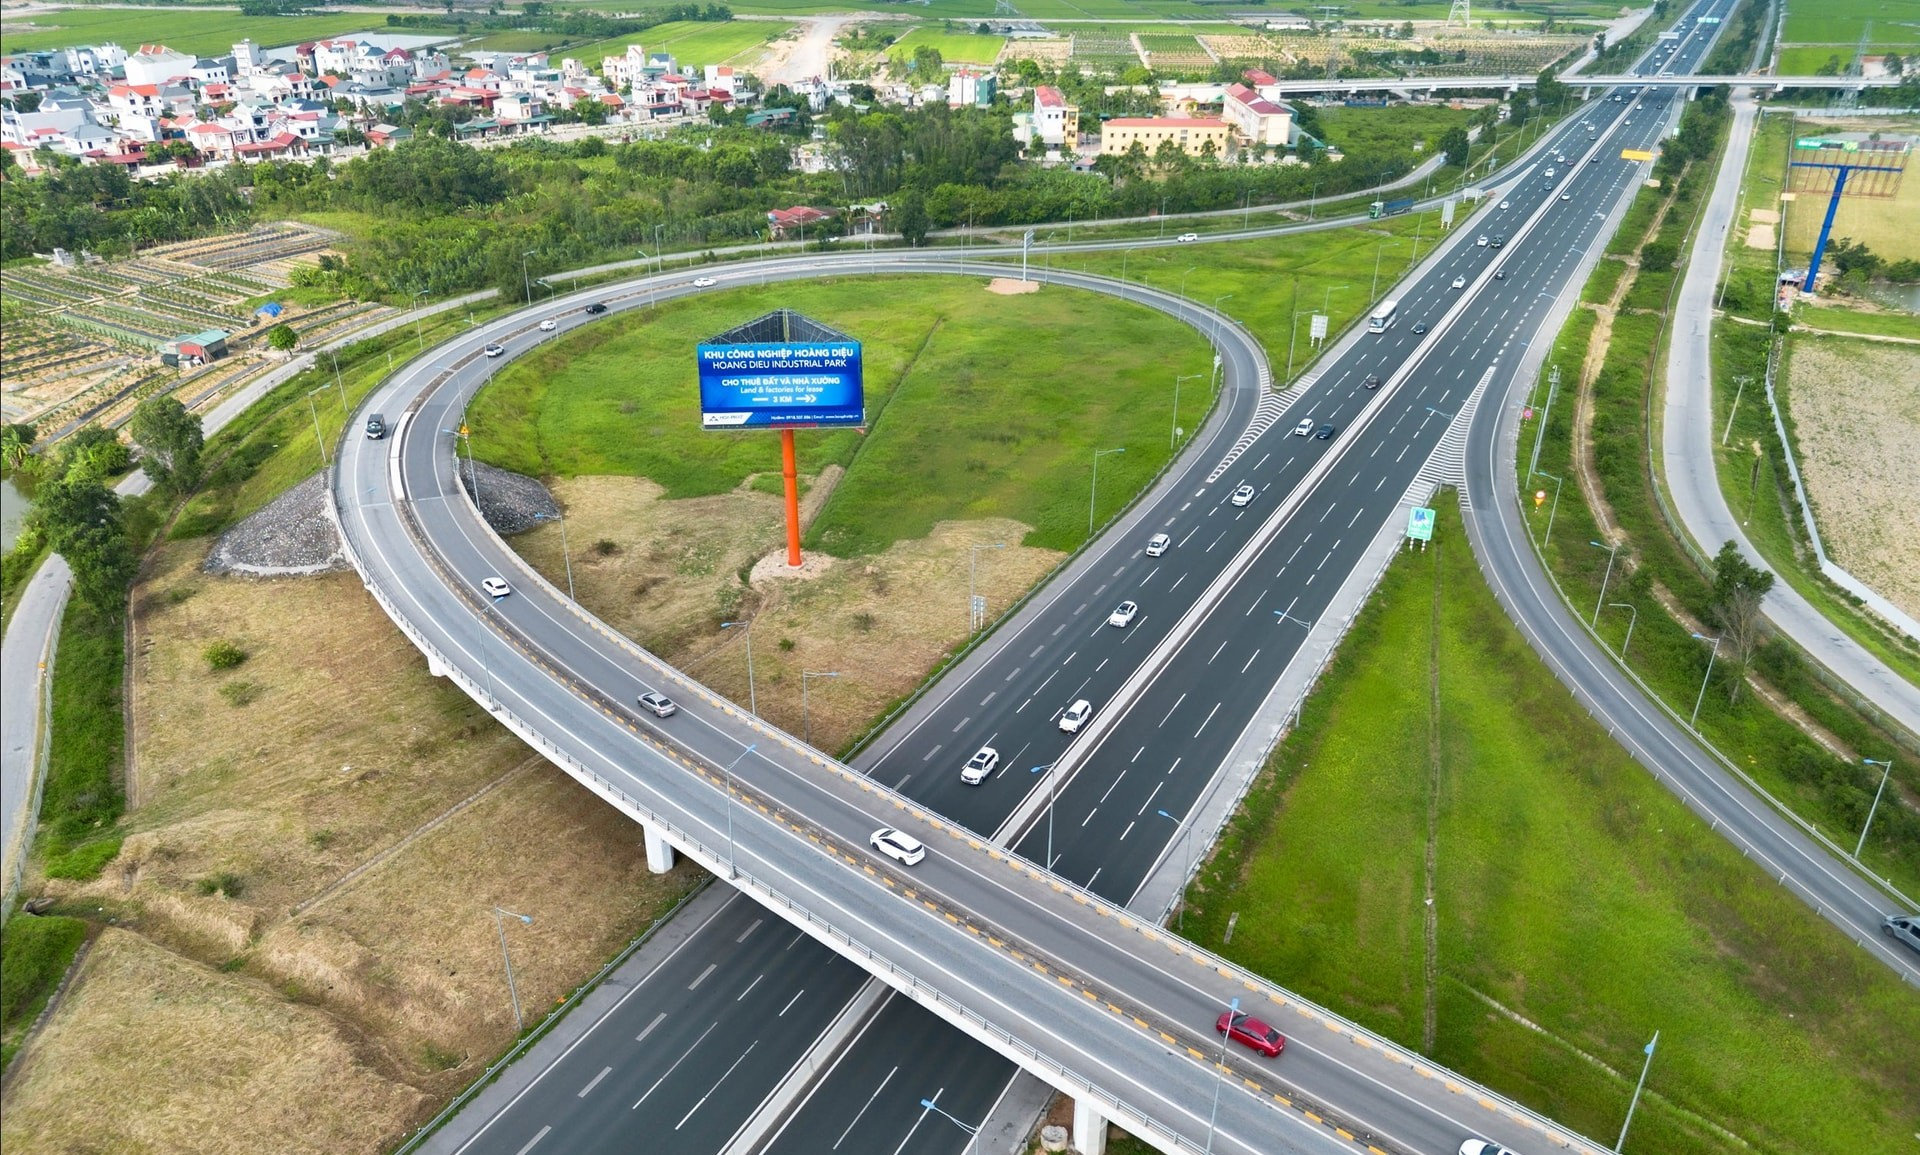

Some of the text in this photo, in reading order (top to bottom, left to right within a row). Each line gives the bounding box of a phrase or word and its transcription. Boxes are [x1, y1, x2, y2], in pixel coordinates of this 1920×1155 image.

[704, 348, 854, 360] KHU CÔNG NGHIỆP HOÀNG DIỆU
[713, 359, 846, 369] HOANG DIEU INDUSTRIAL PARK
[740, 378, 760, 386] THUÊ
[762, 377, 778, 386] ĐẤT
[780, 377, 790, 385] VÀ
[792, 376, 810, 385] NHÀ
